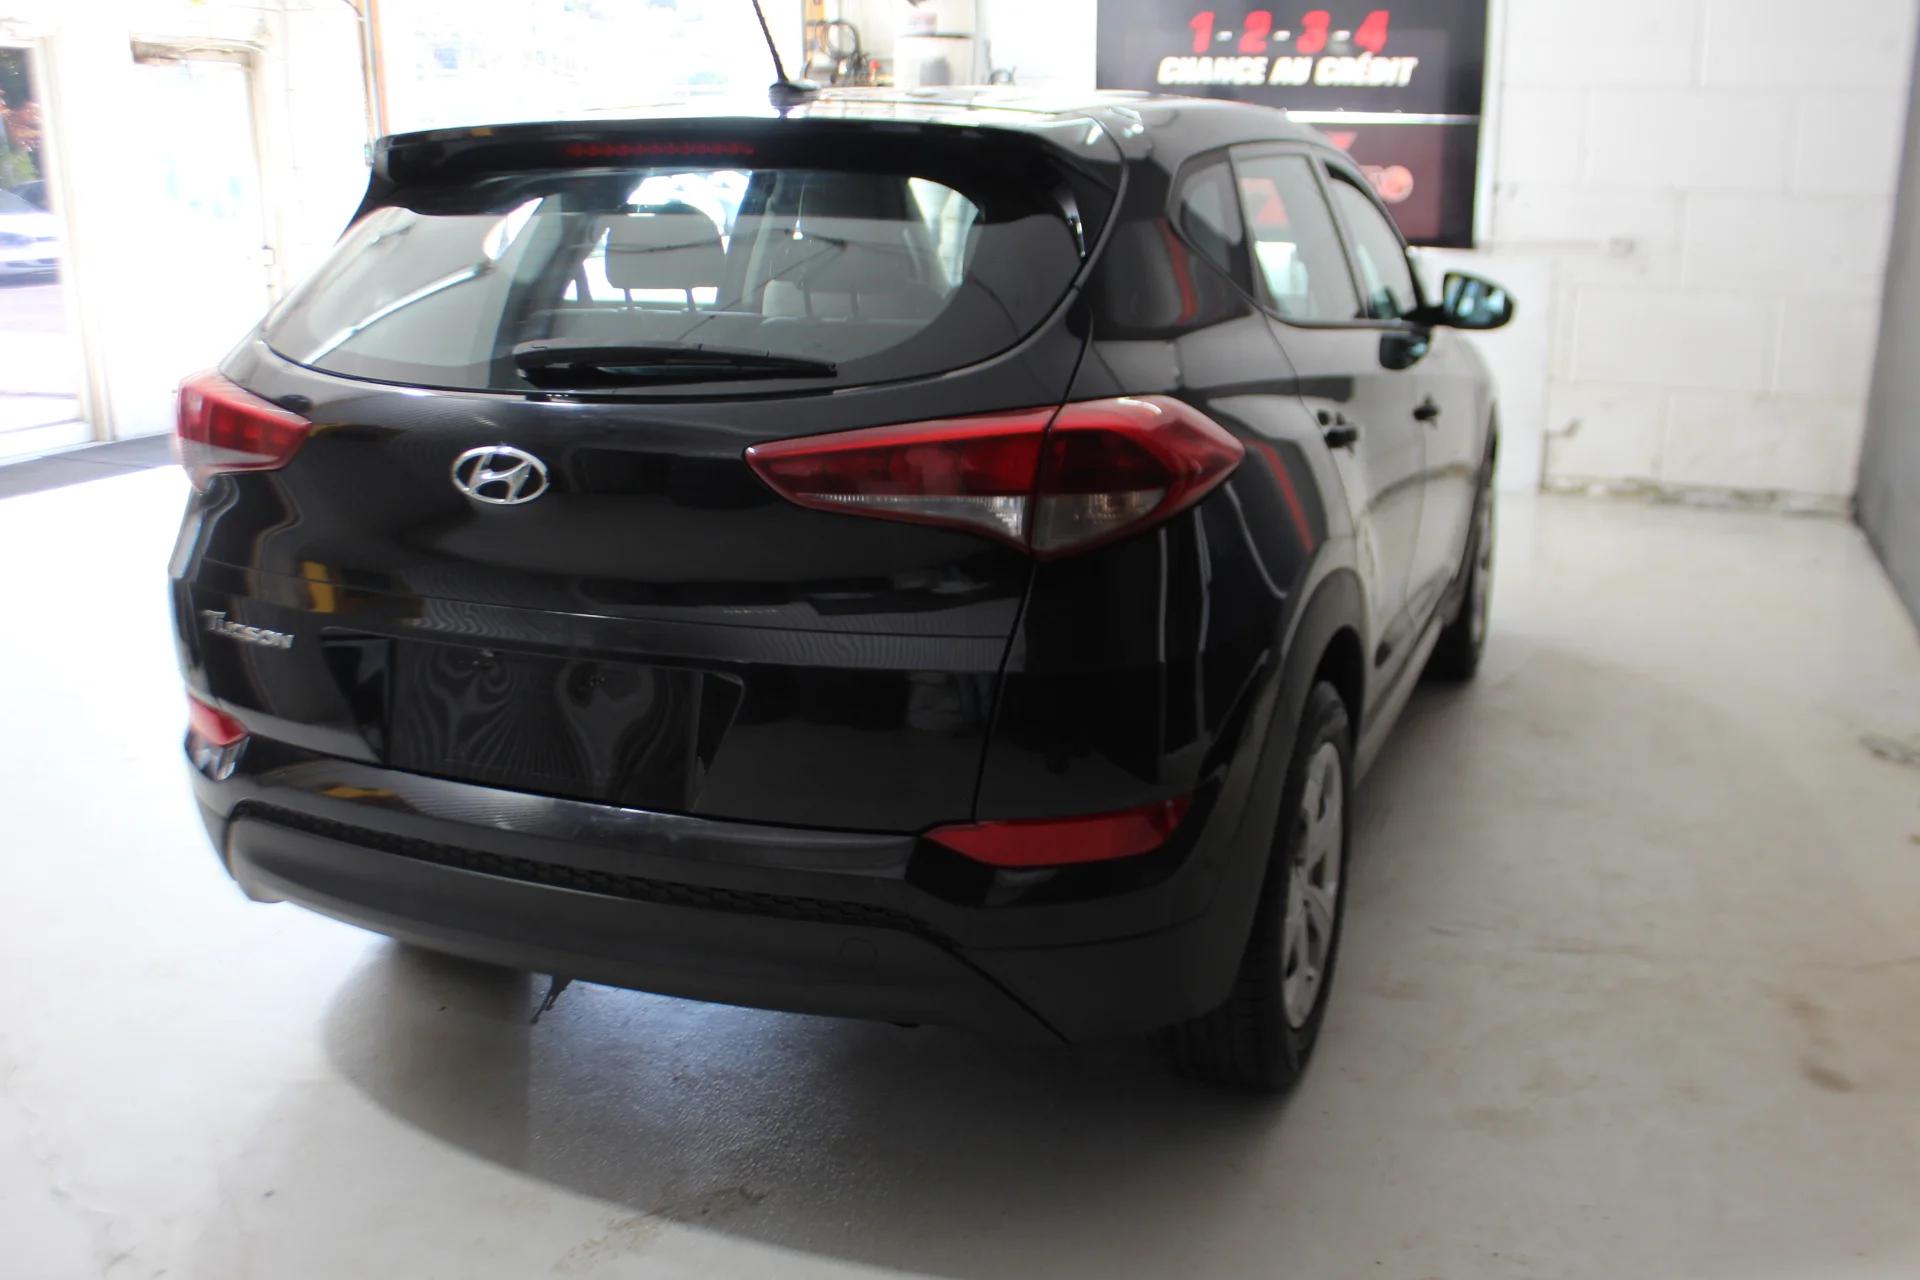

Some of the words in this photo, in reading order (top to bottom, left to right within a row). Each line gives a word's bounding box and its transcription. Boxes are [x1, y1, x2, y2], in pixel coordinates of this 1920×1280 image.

[1157, 56, 1269, 85] CHANCE
[1268, 56, 1313, 85] AU
[1314, 51, 1419, 87] CRÉDIT
